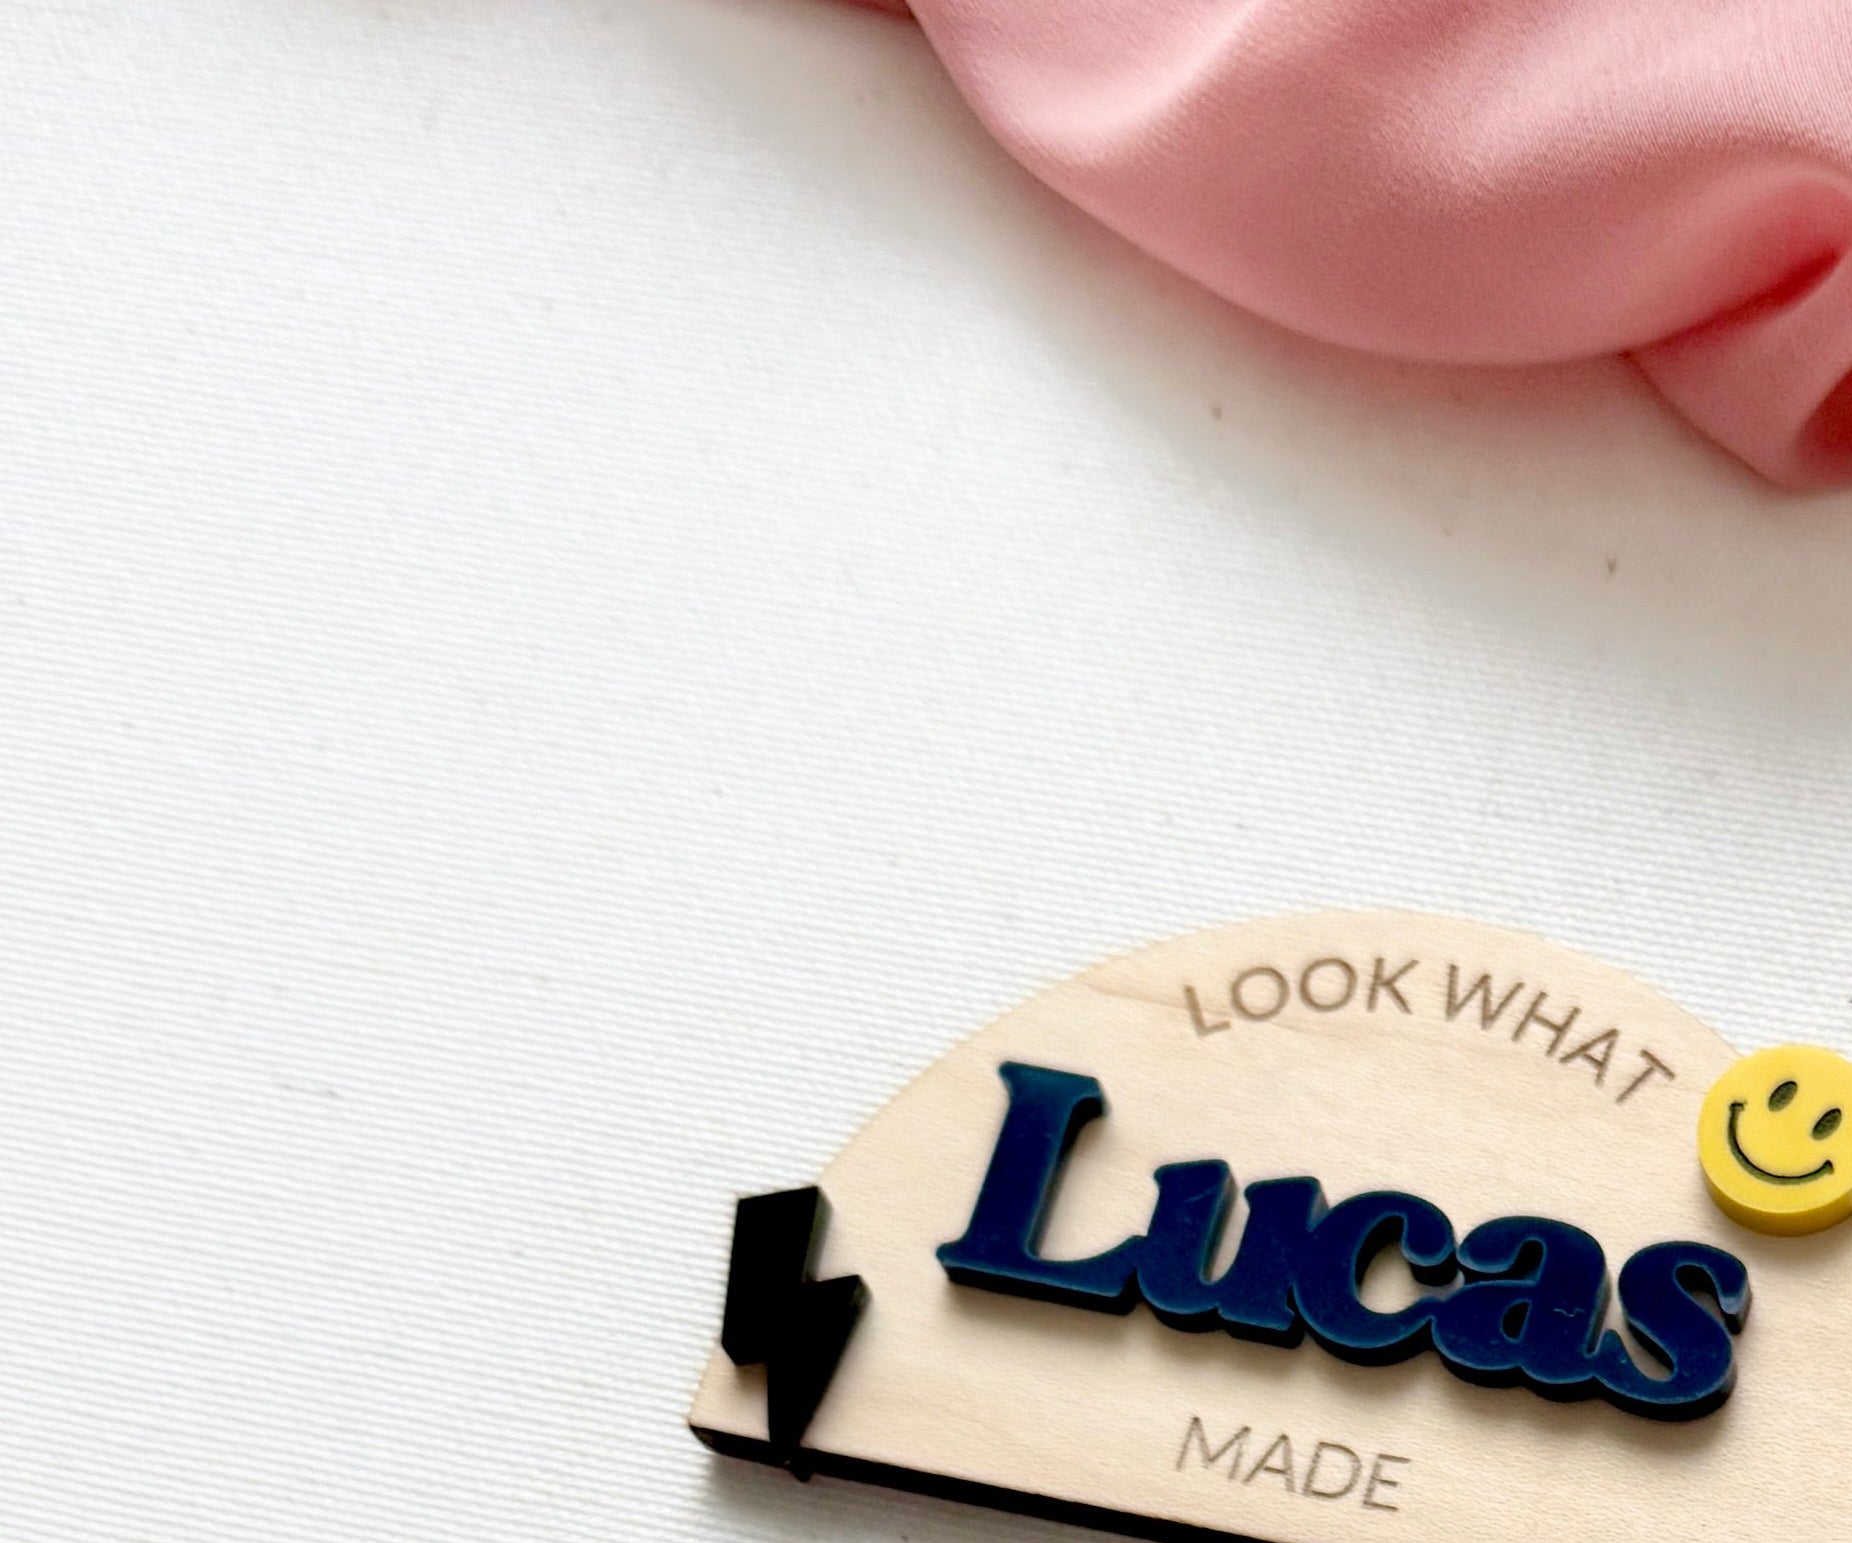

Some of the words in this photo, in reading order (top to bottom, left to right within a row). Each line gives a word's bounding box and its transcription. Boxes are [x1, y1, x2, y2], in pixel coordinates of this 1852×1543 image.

[1183, 956, 1424, 1037] LOOK
[1442, 963, 1677, 1105] WHAT
[935, 1061, 1751, 1421] Lucas
[1175, 1416, 1412, 1514] MADE
